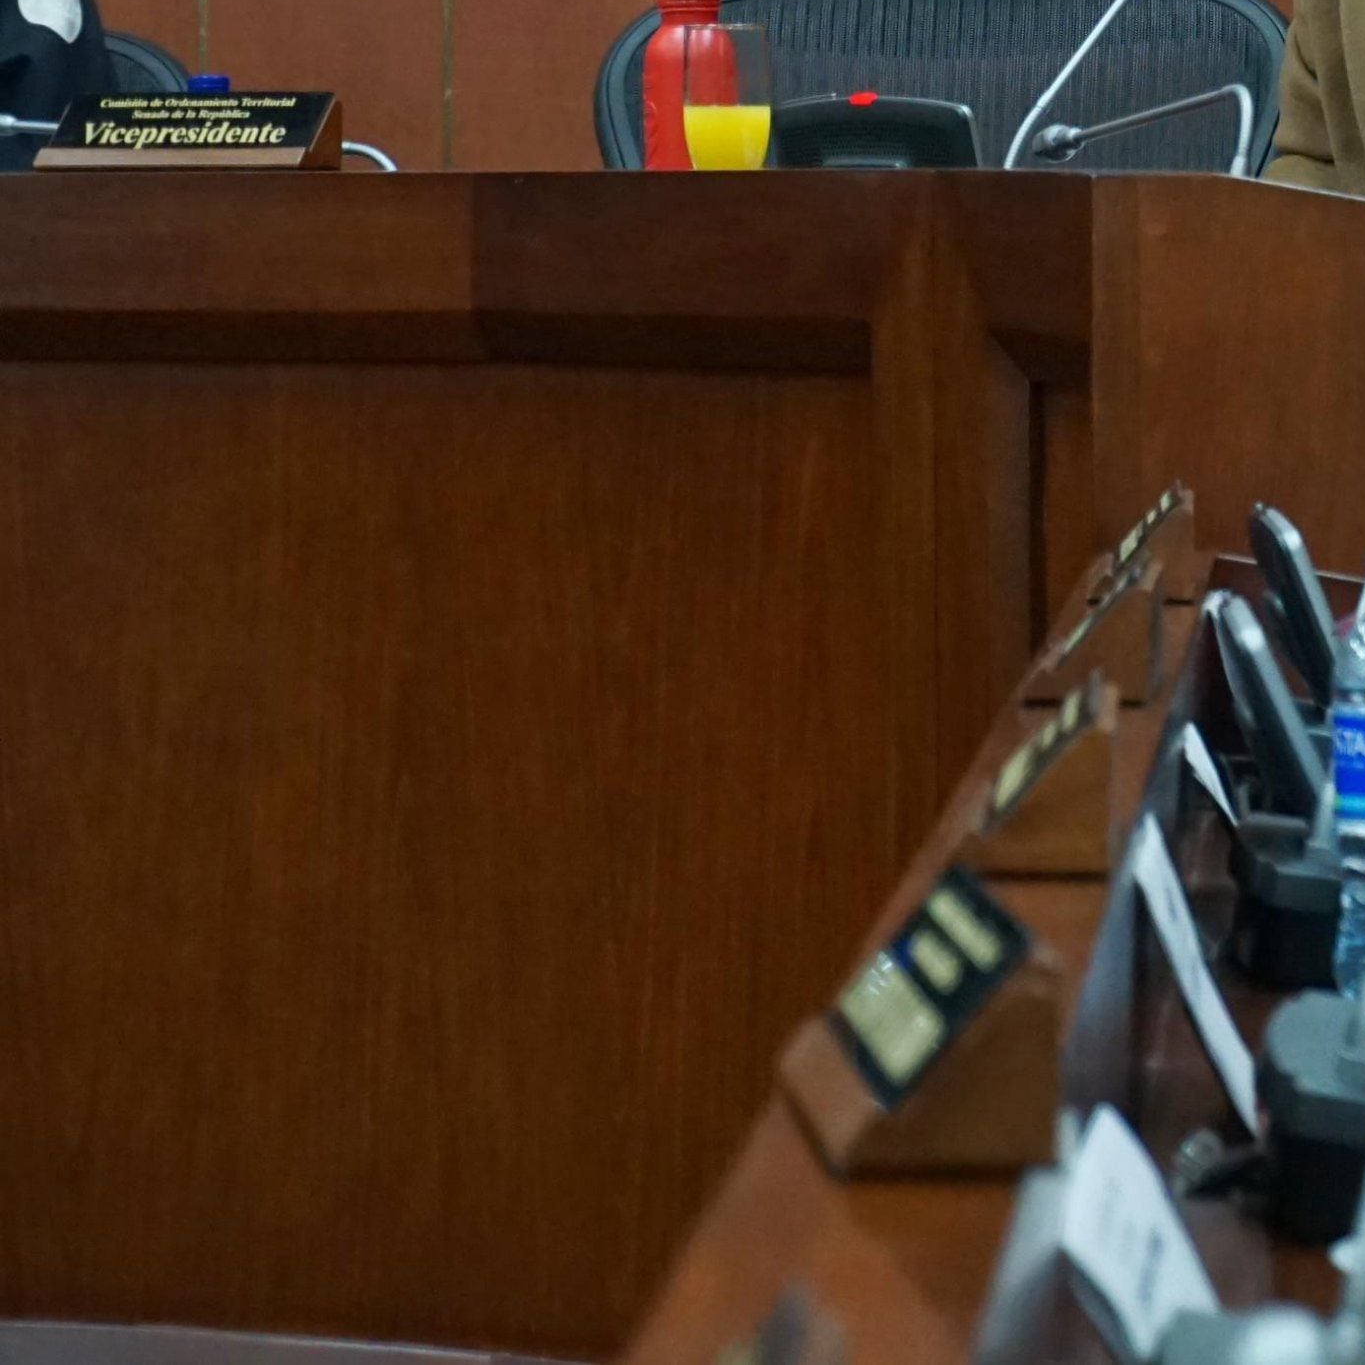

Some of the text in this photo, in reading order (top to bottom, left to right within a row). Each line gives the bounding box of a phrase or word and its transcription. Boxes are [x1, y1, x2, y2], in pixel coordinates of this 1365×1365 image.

[150, 97, 164, 108] de
[165, 97, 238, 108] Ordenamiento
[241, 97, 296, 107] Territorial
[132, 109, 170, 119] Senado
[171, 109, 185, 119] de
[185, 109, 198, 119] la
[84, 121, 287, 150] Vicepresidente
